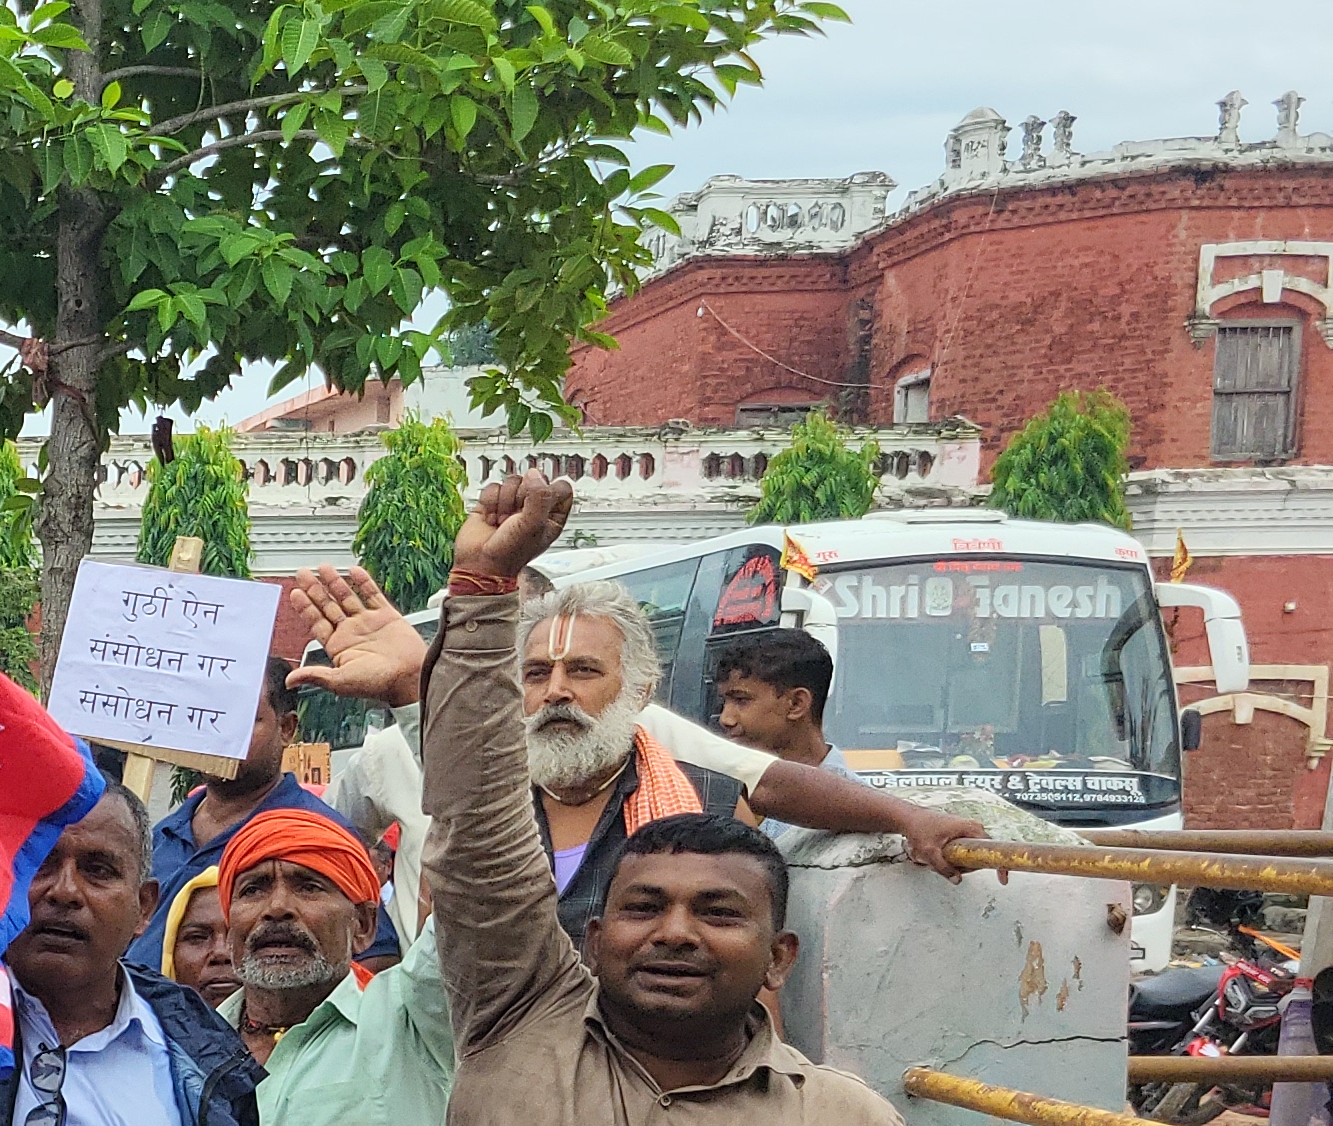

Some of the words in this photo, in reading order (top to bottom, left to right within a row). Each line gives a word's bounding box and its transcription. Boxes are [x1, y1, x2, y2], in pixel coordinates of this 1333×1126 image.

[122, 586, 173, 622] गुठी
[181, 590, 224, 629] ऐन
[834, 574, 919, 618] Shri
[90, 633, 189, 674] संसोधन
[197, 654, 236, 680] गर
[79, 684, 179, 725] संसोधन
[187, 706, 227, 733] गर
